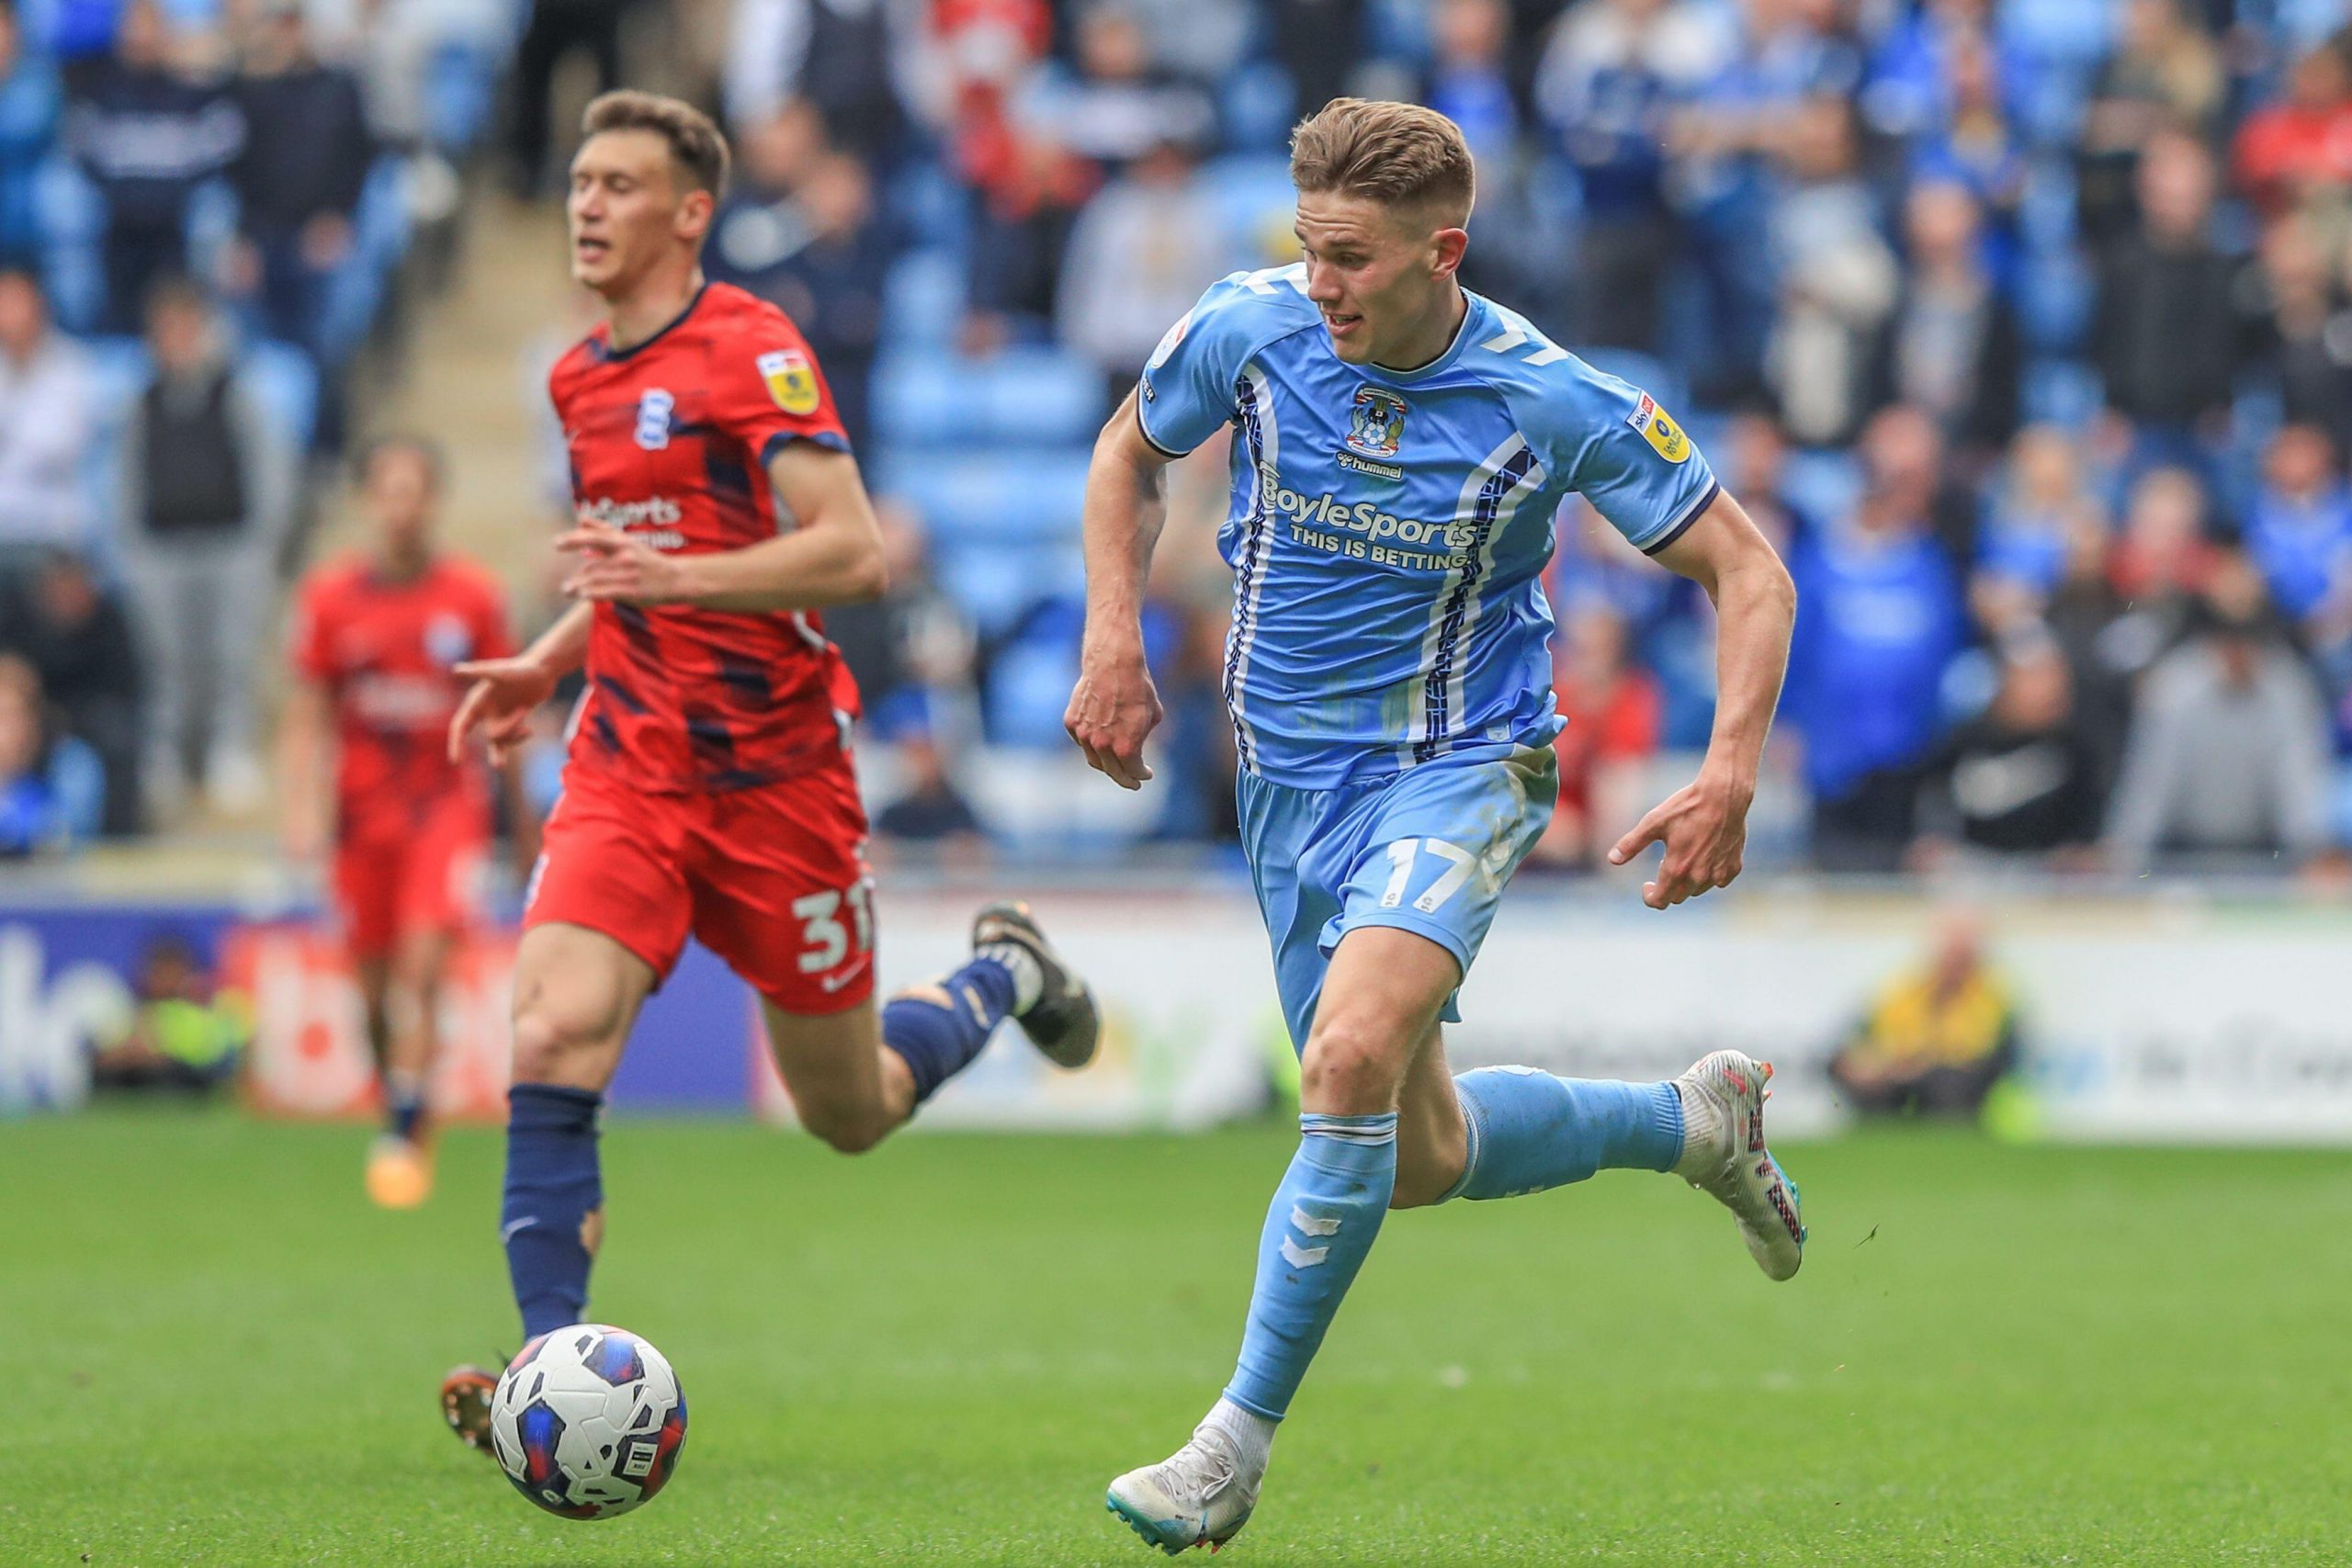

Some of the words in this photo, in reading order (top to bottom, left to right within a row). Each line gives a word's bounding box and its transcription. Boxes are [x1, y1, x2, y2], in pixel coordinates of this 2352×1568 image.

[1635, 412, 1648, 428] sky
[1352, 457, 1402, 479] hummel
[1261, 468, 1478, 547] BoyleSports
[1290, 524, 1340, 553] THIS
[1344, 538, 1366, 558] IS
[1380, 838, 1477, 914] 17
[792, 882, 871, 974] 31
